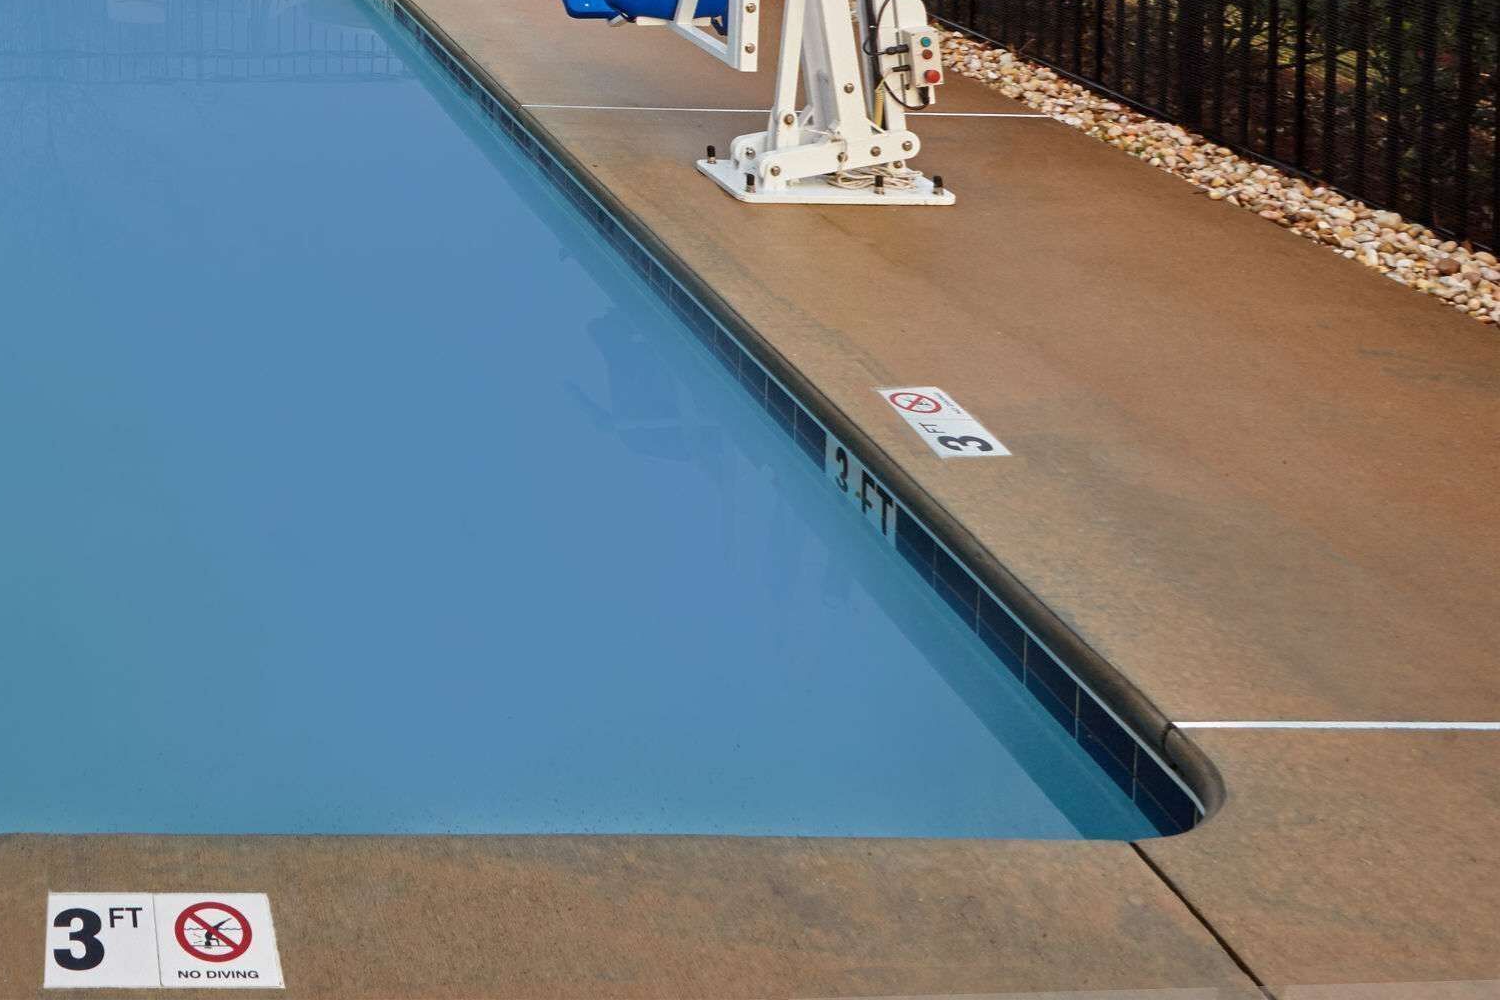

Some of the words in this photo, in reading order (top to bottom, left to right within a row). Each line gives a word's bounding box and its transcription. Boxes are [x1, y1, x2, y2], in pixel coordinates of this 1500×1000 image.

[937, 435, 993, 452] 3
[835, 446, 849, 493] 3
[861, 469, 894, 536] FT
[53, 908, 105, 971] 3
[109, 907, 143, 928] FT
[178, 970, 201, 979] NO
[206, 970, 260, 979] DIVING
